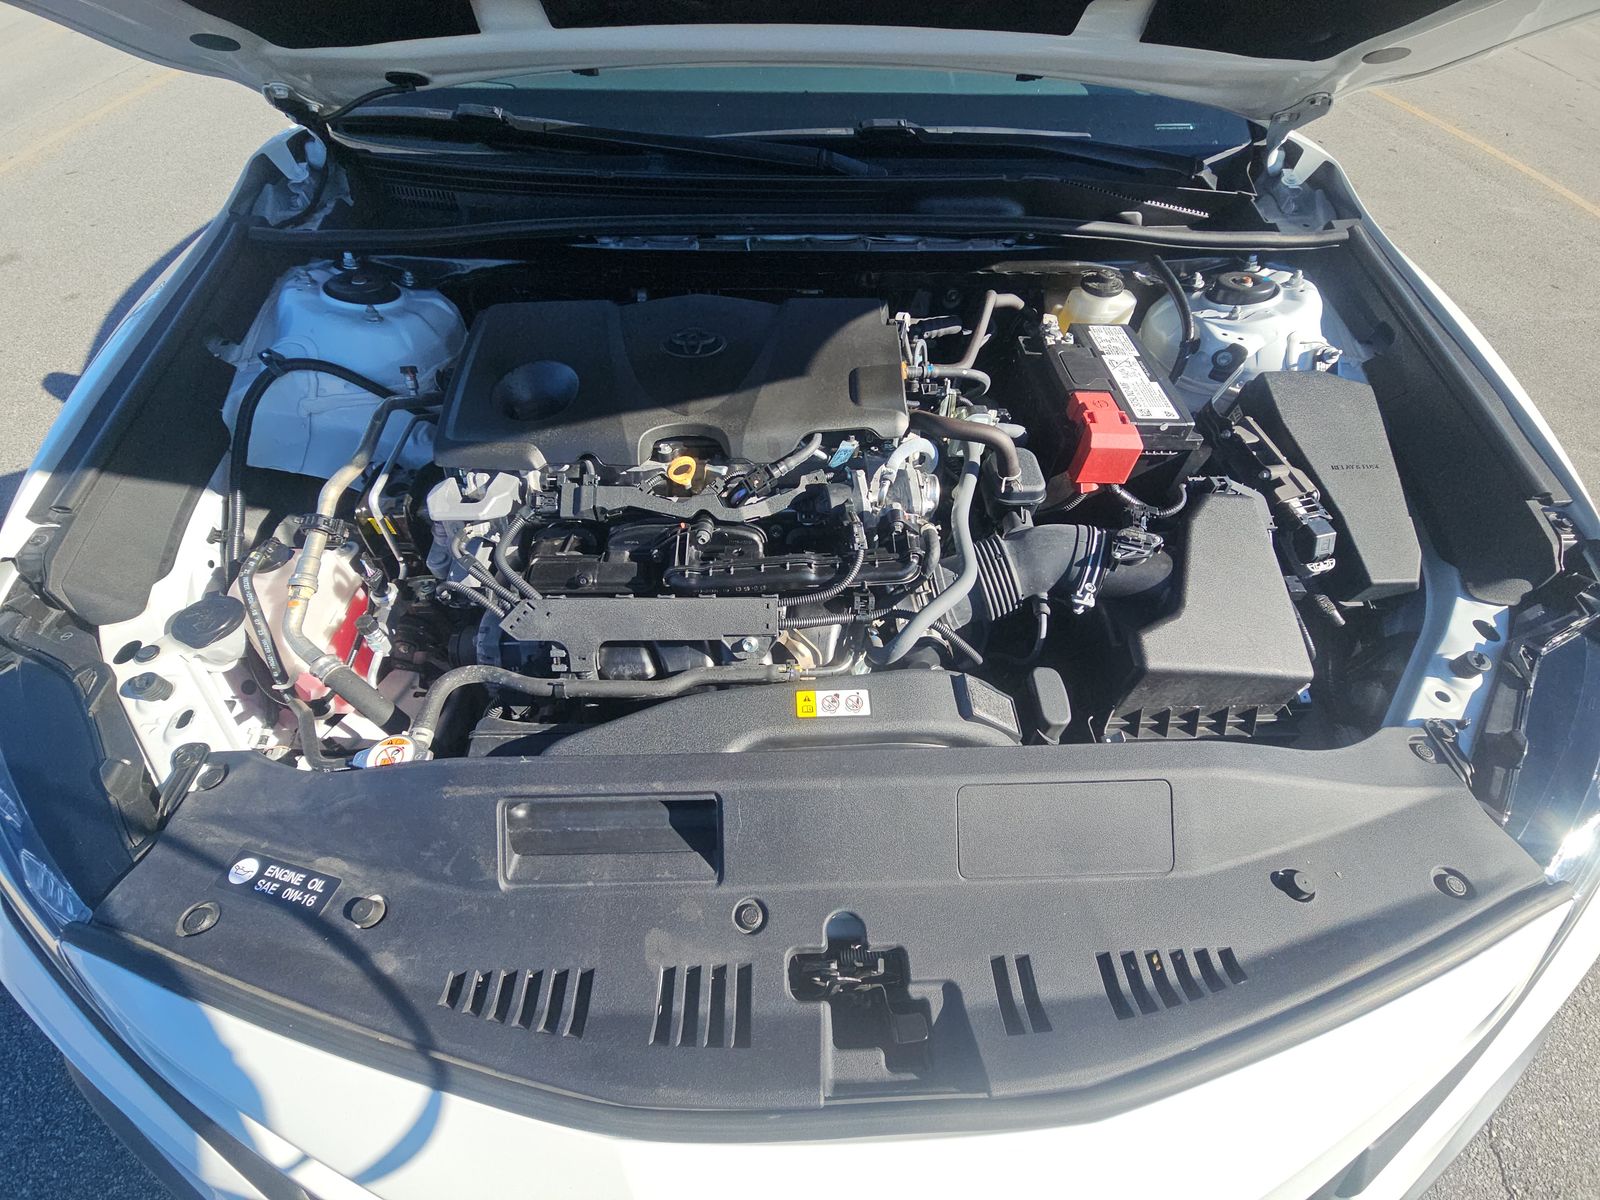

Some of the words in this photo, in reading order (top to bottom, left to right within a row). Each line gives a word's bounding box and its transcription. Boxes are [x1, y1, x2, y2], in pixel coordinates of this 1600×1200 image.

[264, 865, 306, 885] ENGINE
[308, 878, 326, 892] OIL
[254, 879, 280, 895] SAE
[281, 888, 317, 907] 0W-16
